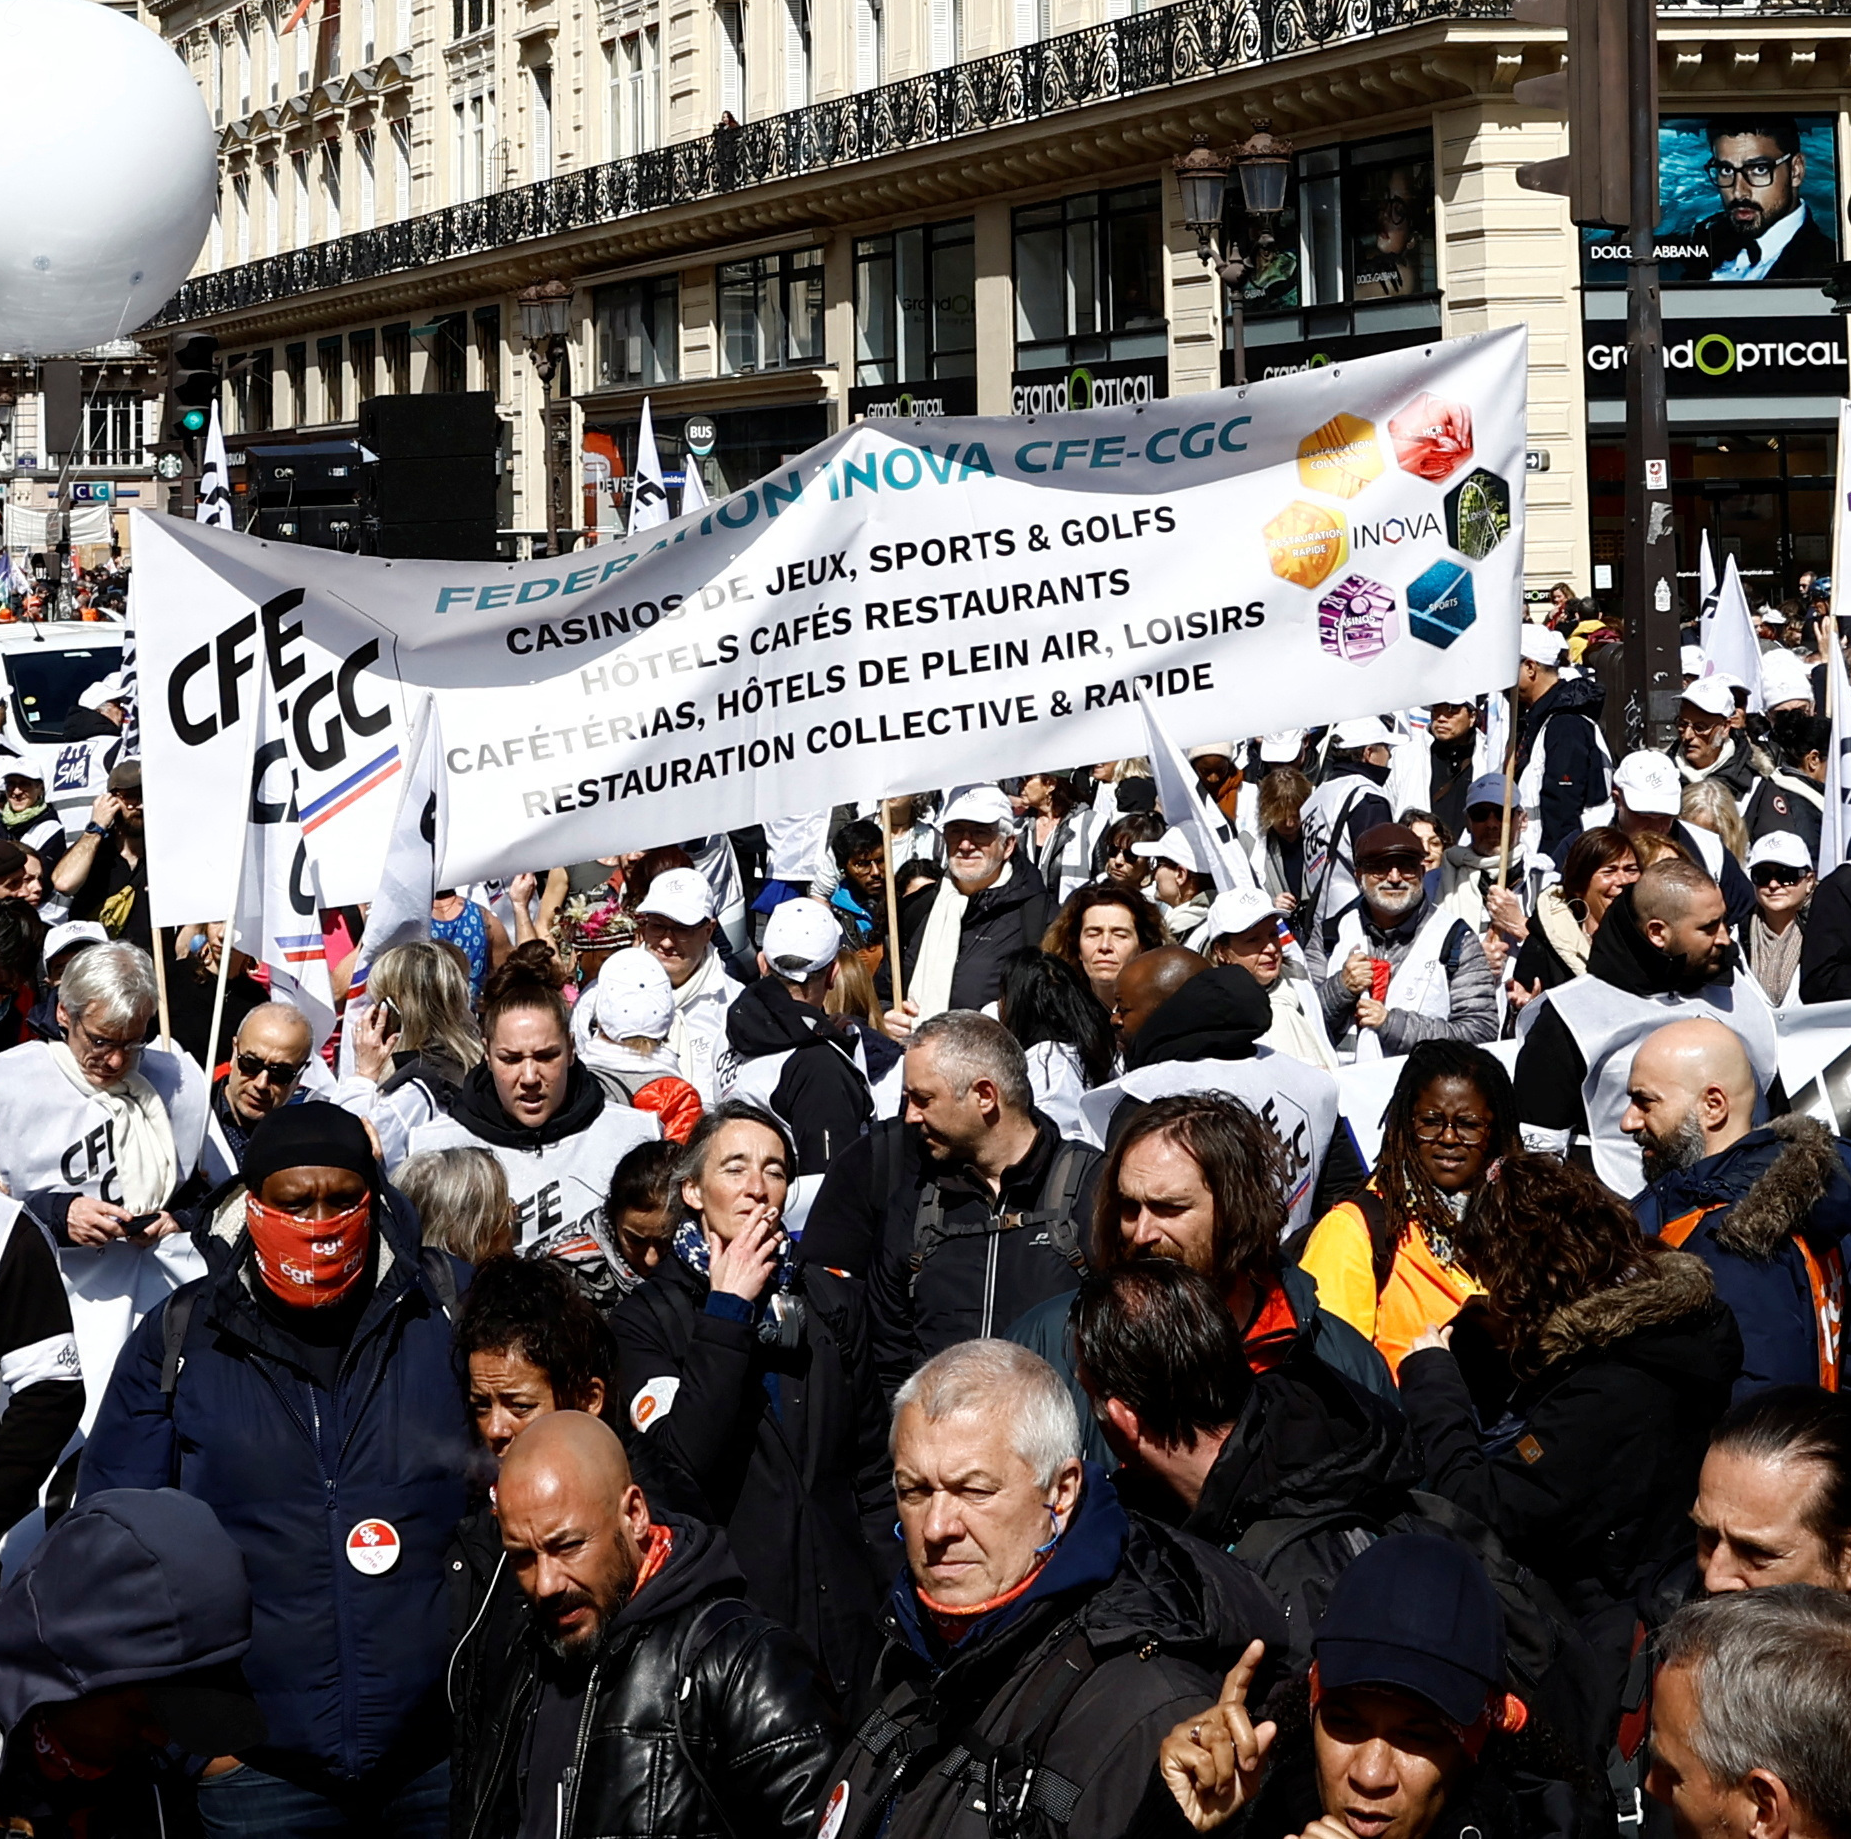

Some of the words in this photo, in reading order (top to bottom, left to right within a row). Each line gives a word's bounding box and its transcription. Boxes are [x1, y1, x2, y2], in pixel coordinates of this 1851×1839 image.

[1652, 245, 1709, 259] ABBANA
[690, 426, 712, 438] BUS
[1422, 425, 1444, 437] HCR
[75, 484, 110, 500] CIC
[435, 471, 805, 615] FEDERION
[823, 440, 996, 502] INOVA
[1014, 416, 1252, 474] CFE-CGC
[1353, 512, 1442, 549] INOVA
[1269, 528, 1344, 551] RESTAURATION
[1292, 543, 1327, 558] RAPIDE
[505, 593, 686, 656] CASINOS
[700, 573, 755, 614] DE
[766, 544, 858, 596] JEUX,
[868, 528, 1017, 573] SPORTS
[1028, 523, 1051, 553] &
[1060, 505, 1177, 548] GOLFS
[1334, 613, 1376, 629] CASINOS
[1427, 599, 1458, 613] SPORTS
[580, 636, 740, 697] HÔTELS
[748, 603, 853, 657] CAFÉS
[864, 568, 1131, 631] RESTAURANTS
[167, 587, 306, 748] CFE
[447, 700, 707, 776] CAFÉTÉRIAS,
[716, 663, 846, 723] HÔTELS
[858, 655, 909, 689] DE
[921, 638, 1030, 682] PLEIN
[1041, 625, 1115, 664] AIR,
[1123, 600, 1267, 652] LOISIRS
[278, 637, 393, 772] GC
[522, 737, 795, 820] RESTAURATION
[805, 690, 1039, 755] COLLECTIVE
[1049, 689, 1074, 718] &
[1083, 662, 1216, 711] RAPIDE
[60, 1118, 115, 1188] CF
[280, 1263, 314, 1284] cgt
